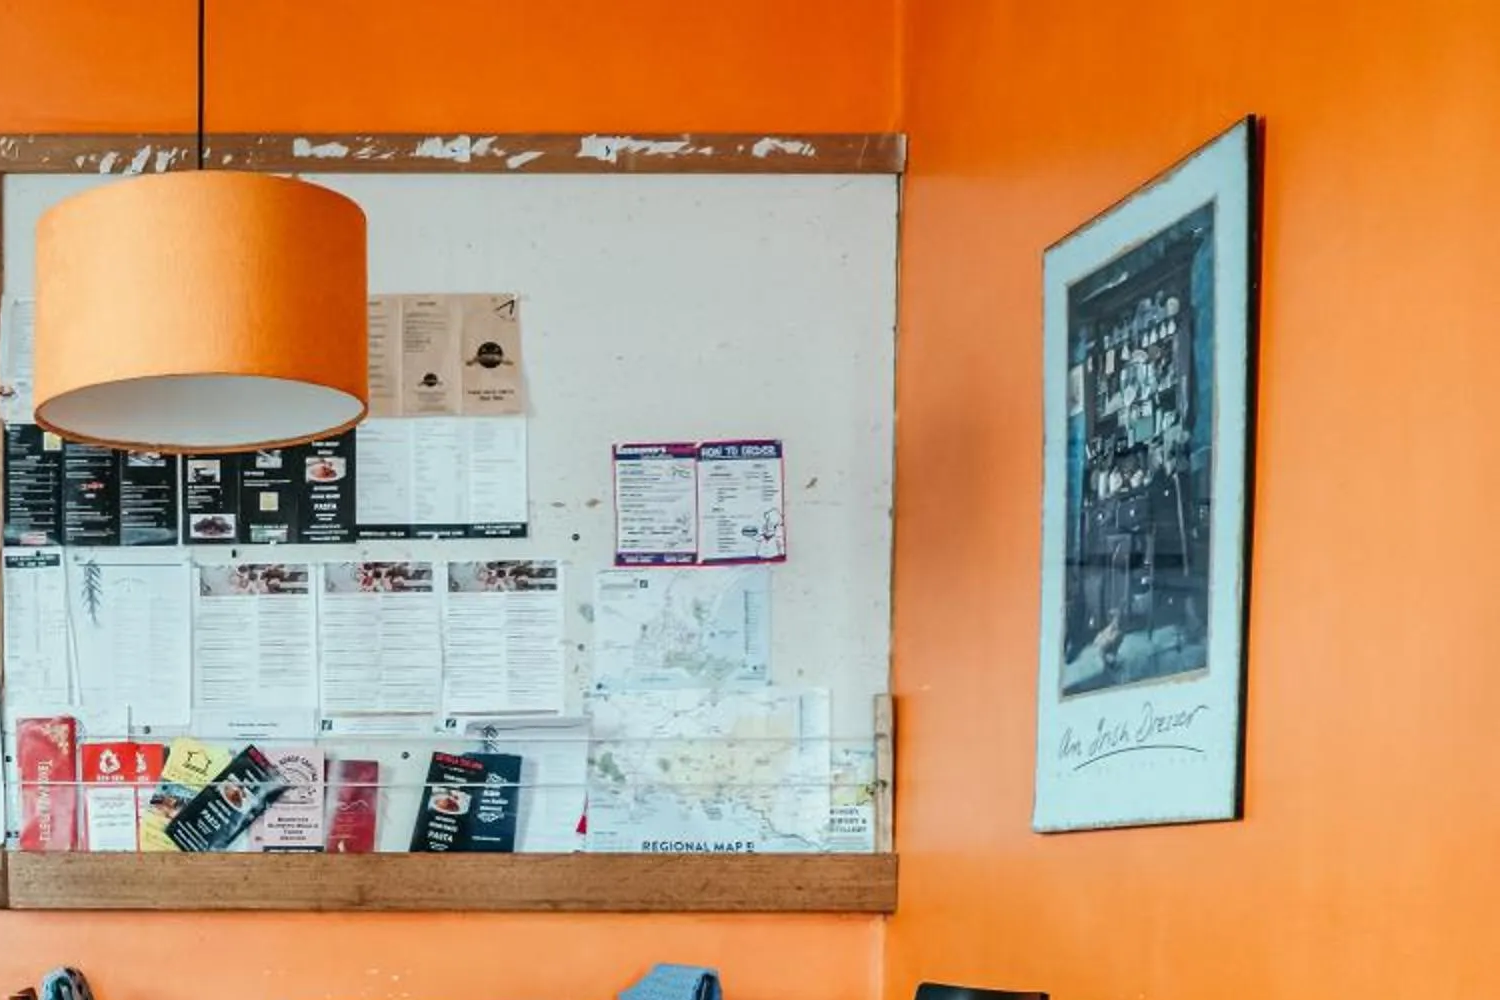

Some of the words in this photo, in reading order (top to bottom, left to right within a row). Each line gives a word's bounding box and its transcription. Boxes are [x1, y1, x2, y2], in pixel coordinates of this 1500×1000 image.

[1058, 726, 1082, 759] An
[1089, 716, 1131, 757] Irish
[1134, 700, 1211, 743] Dresser
[641, 840, 711, 853] REGIONAL
[713, 840, 743, 852] MAP
